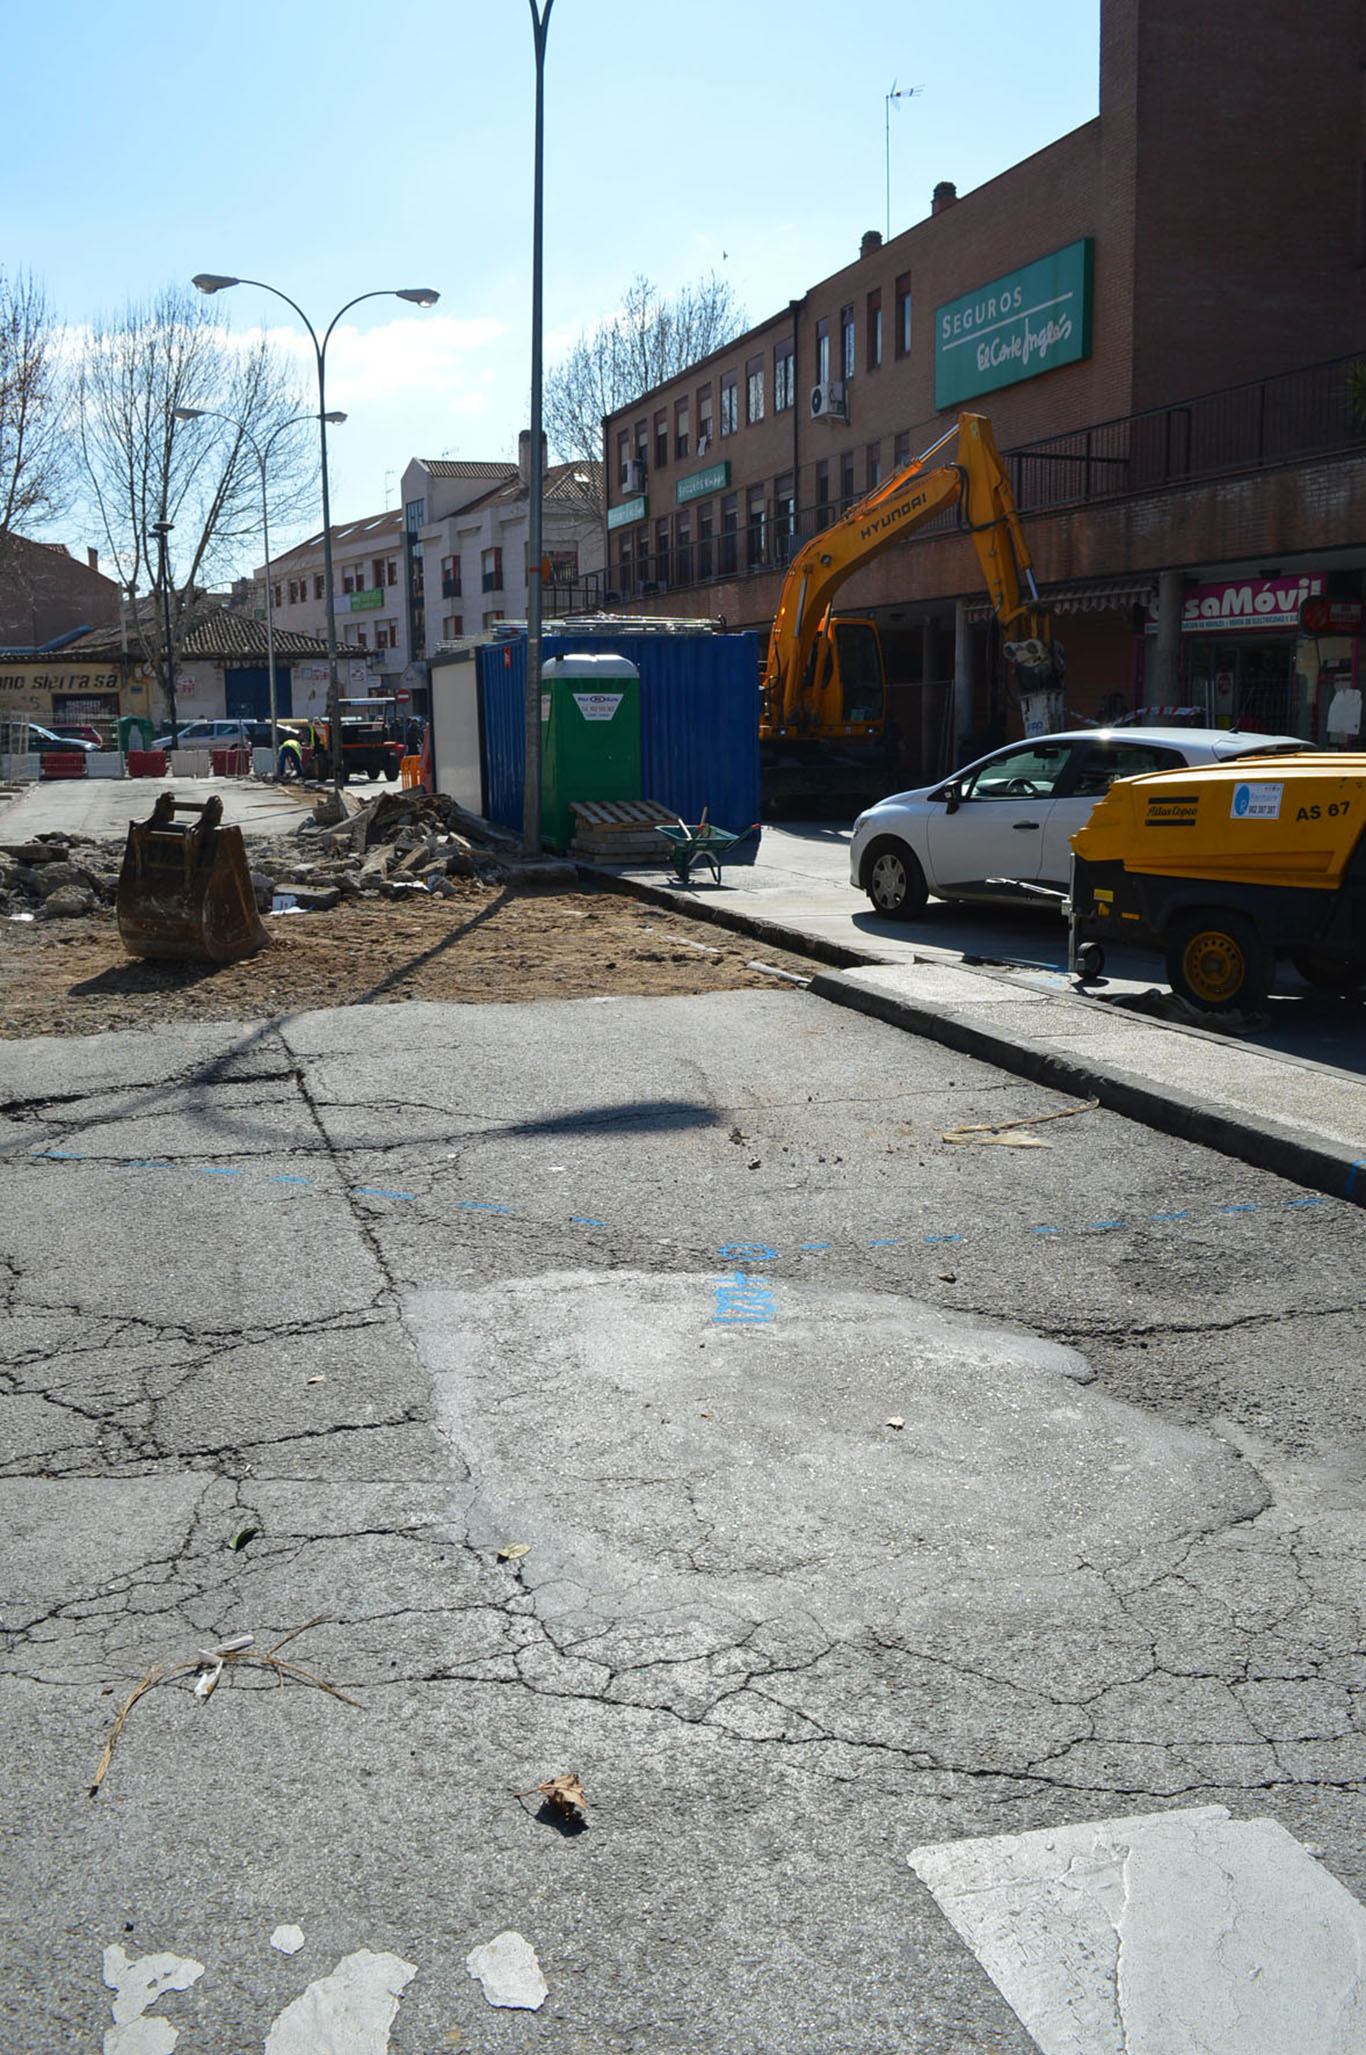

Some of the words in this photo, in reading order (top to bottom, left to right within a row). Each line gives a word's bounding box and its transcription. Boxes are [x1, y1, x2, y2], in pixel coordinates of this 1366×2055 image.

[942, 286, 1022, 340] SEGUROS
[990, 335, 1021, 367] Corte
[1022, 313, 1073, 366] Inglés
[860, 492, 927, 540] HYUNDAI
[1147, 806, 1172, 816] Atlas
[1296, 805, 1321, 822] AS
[1328, 801, 1350, 817] 67
